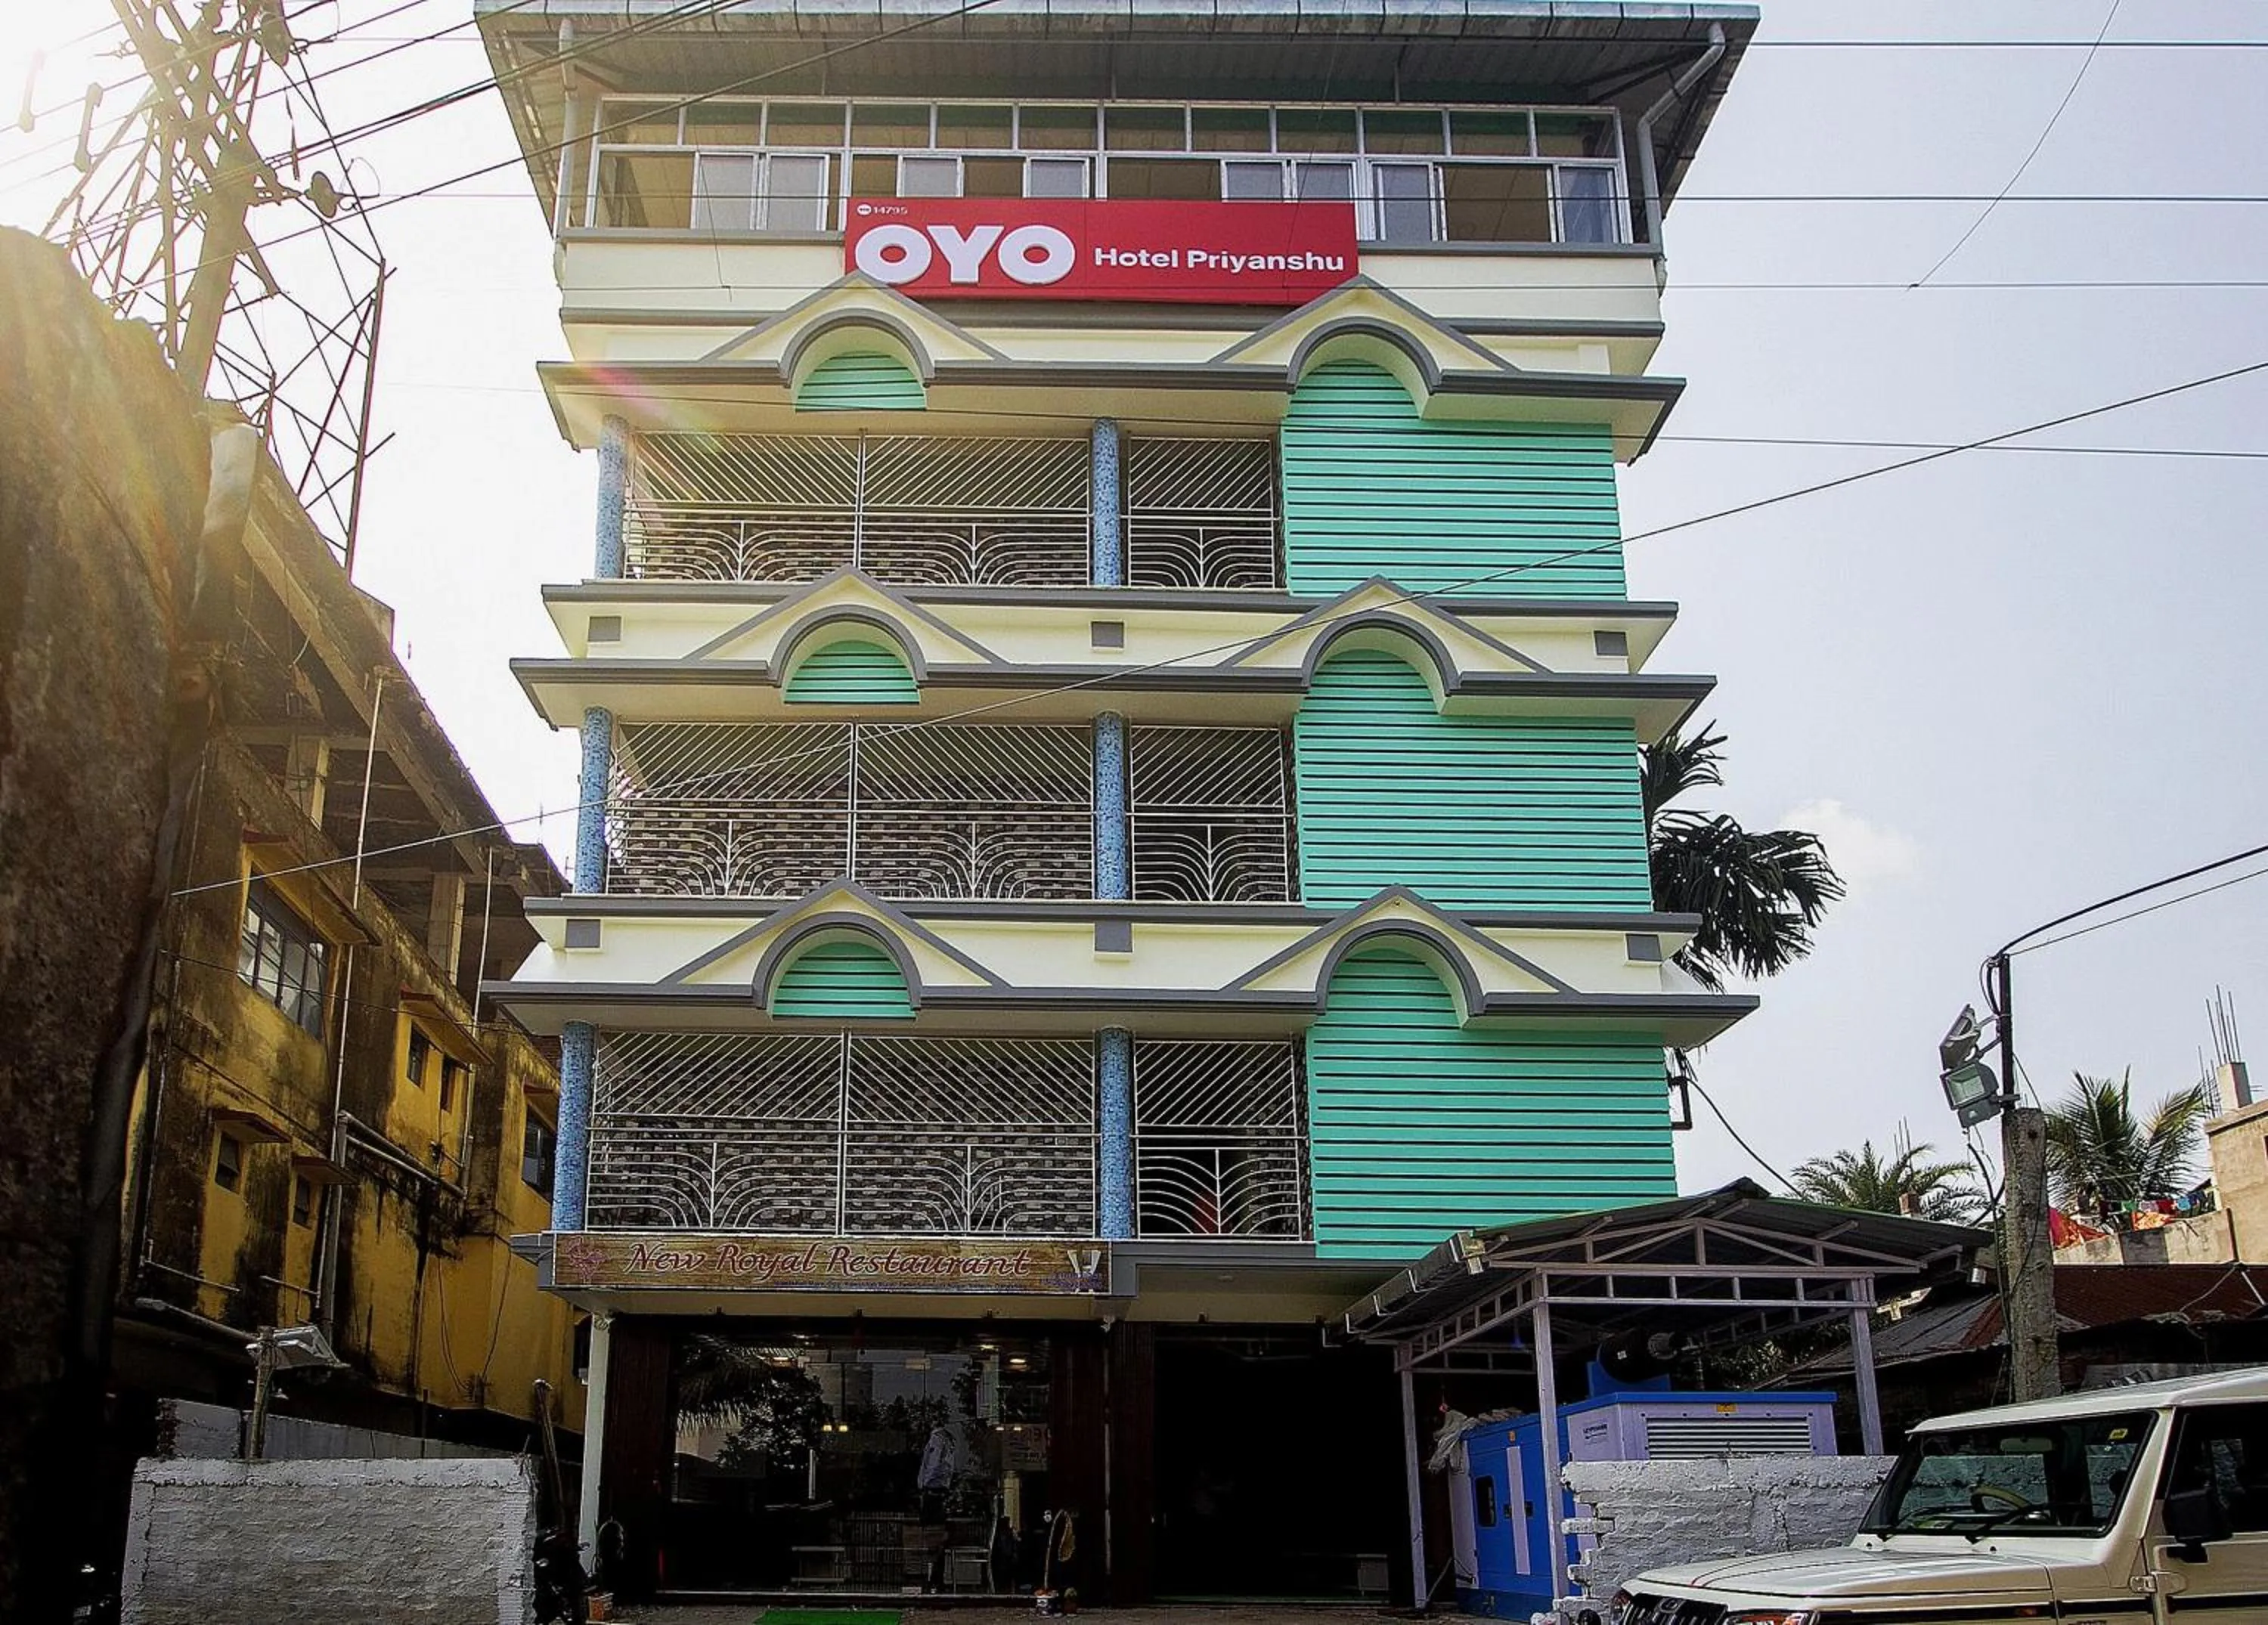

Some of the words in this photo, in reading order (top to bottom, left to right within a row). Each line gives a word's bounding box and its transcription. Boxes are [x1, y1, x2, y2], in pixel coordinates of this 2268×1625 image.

[855, 224, 1077, 285] OYO
[1095, 248, 1179, 267] Hotel
[1187, 250, 1344, 274] Priyanshu
[623, 1242, 708, 1274] New
[715, 1242, 823, 1281] Royal
[826, 1245, 1031, 1277] Restaurant
